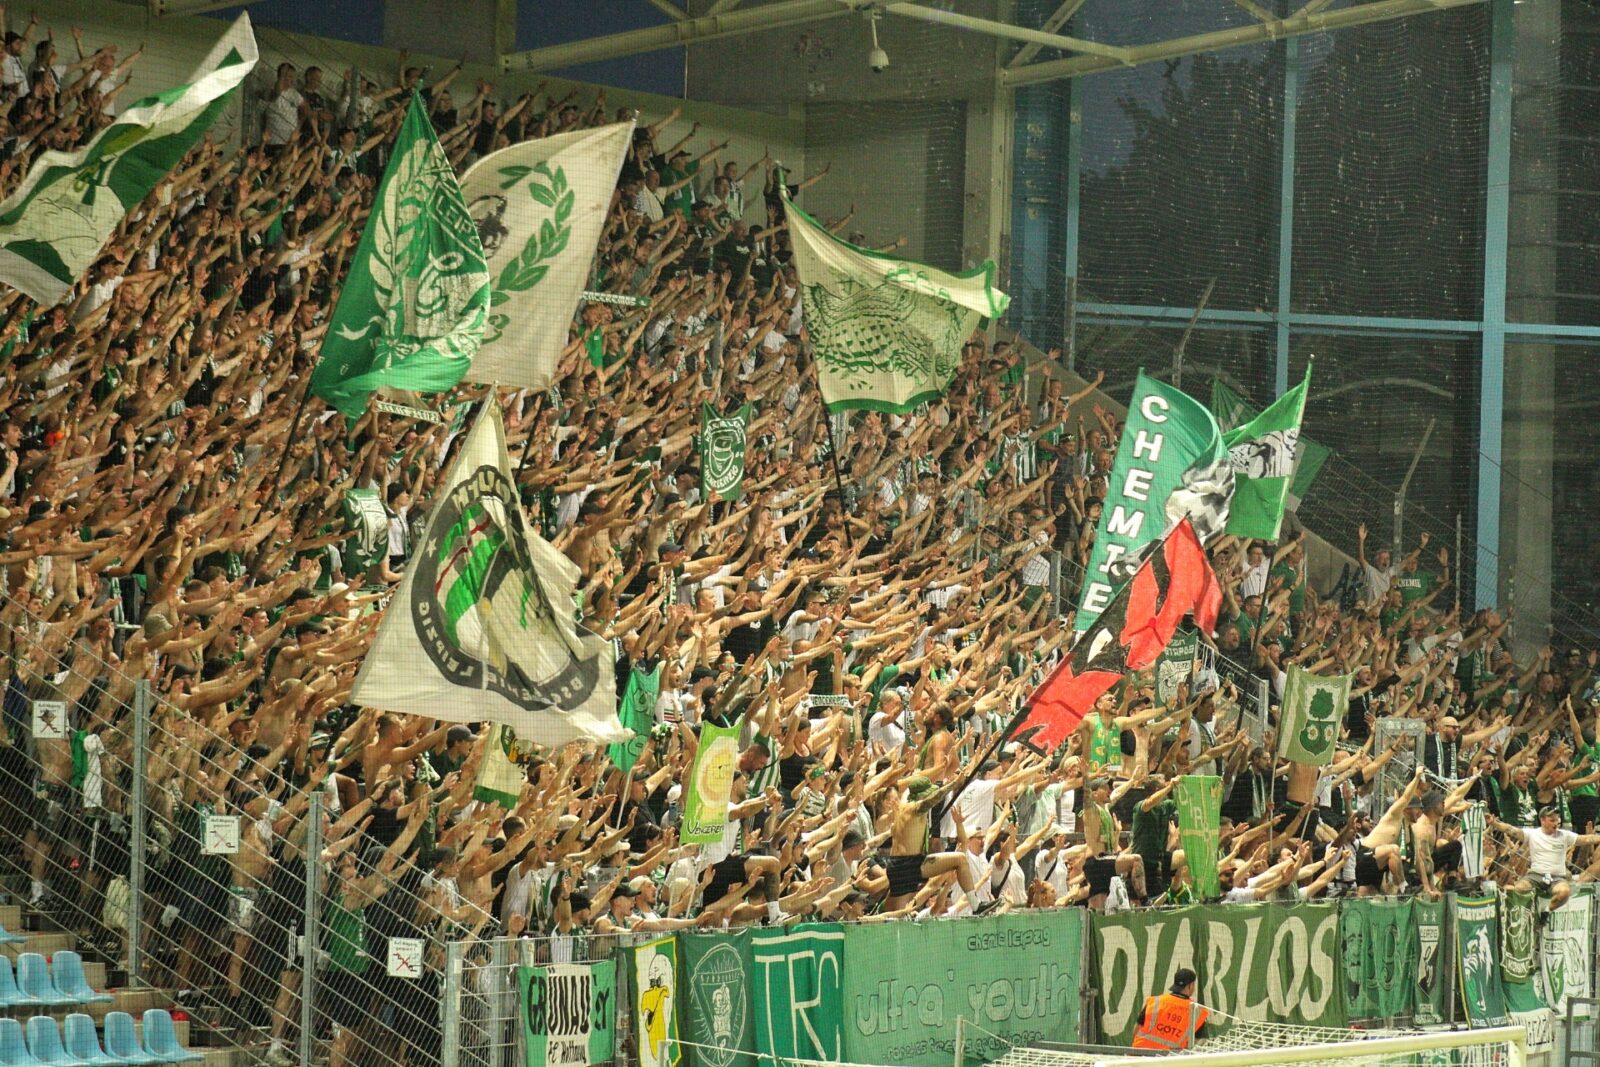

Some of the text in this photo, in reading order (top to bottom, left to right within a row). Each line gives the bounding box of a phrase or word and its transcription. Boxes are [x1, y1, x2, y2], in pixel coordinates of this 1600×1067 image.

[1082, 394, 1169, 613] CHEMIE
[1100, 913, 1338, 1037] DIABLOS
[1167, 1012, 1183, 1024] 199
